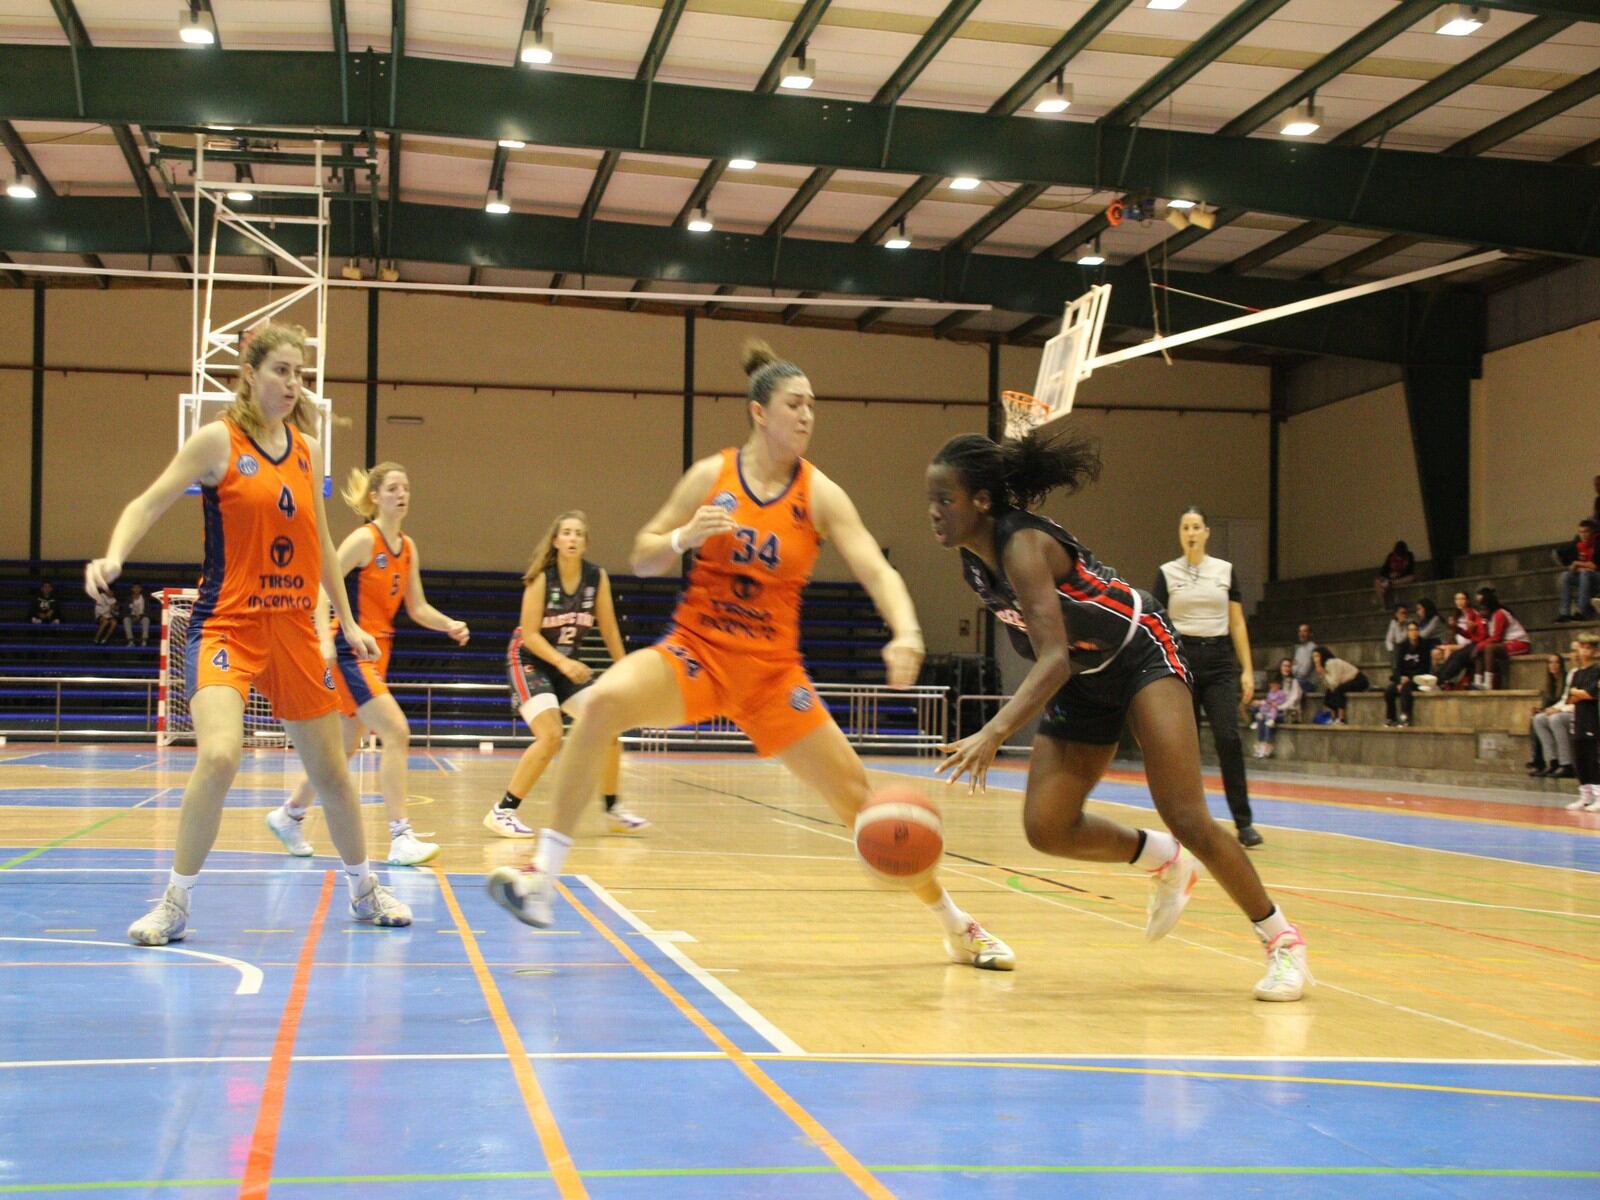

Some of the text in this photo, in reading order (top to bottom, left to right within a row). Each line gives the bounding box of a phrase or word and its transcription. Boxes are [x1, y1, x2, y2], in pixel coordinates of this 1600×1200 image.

[278, 485, 296, 519] 4
[732, 528, 781, 571] 34
[259, 574, 305, 589] TIRSO
[212, 648, 230, 671] 4
